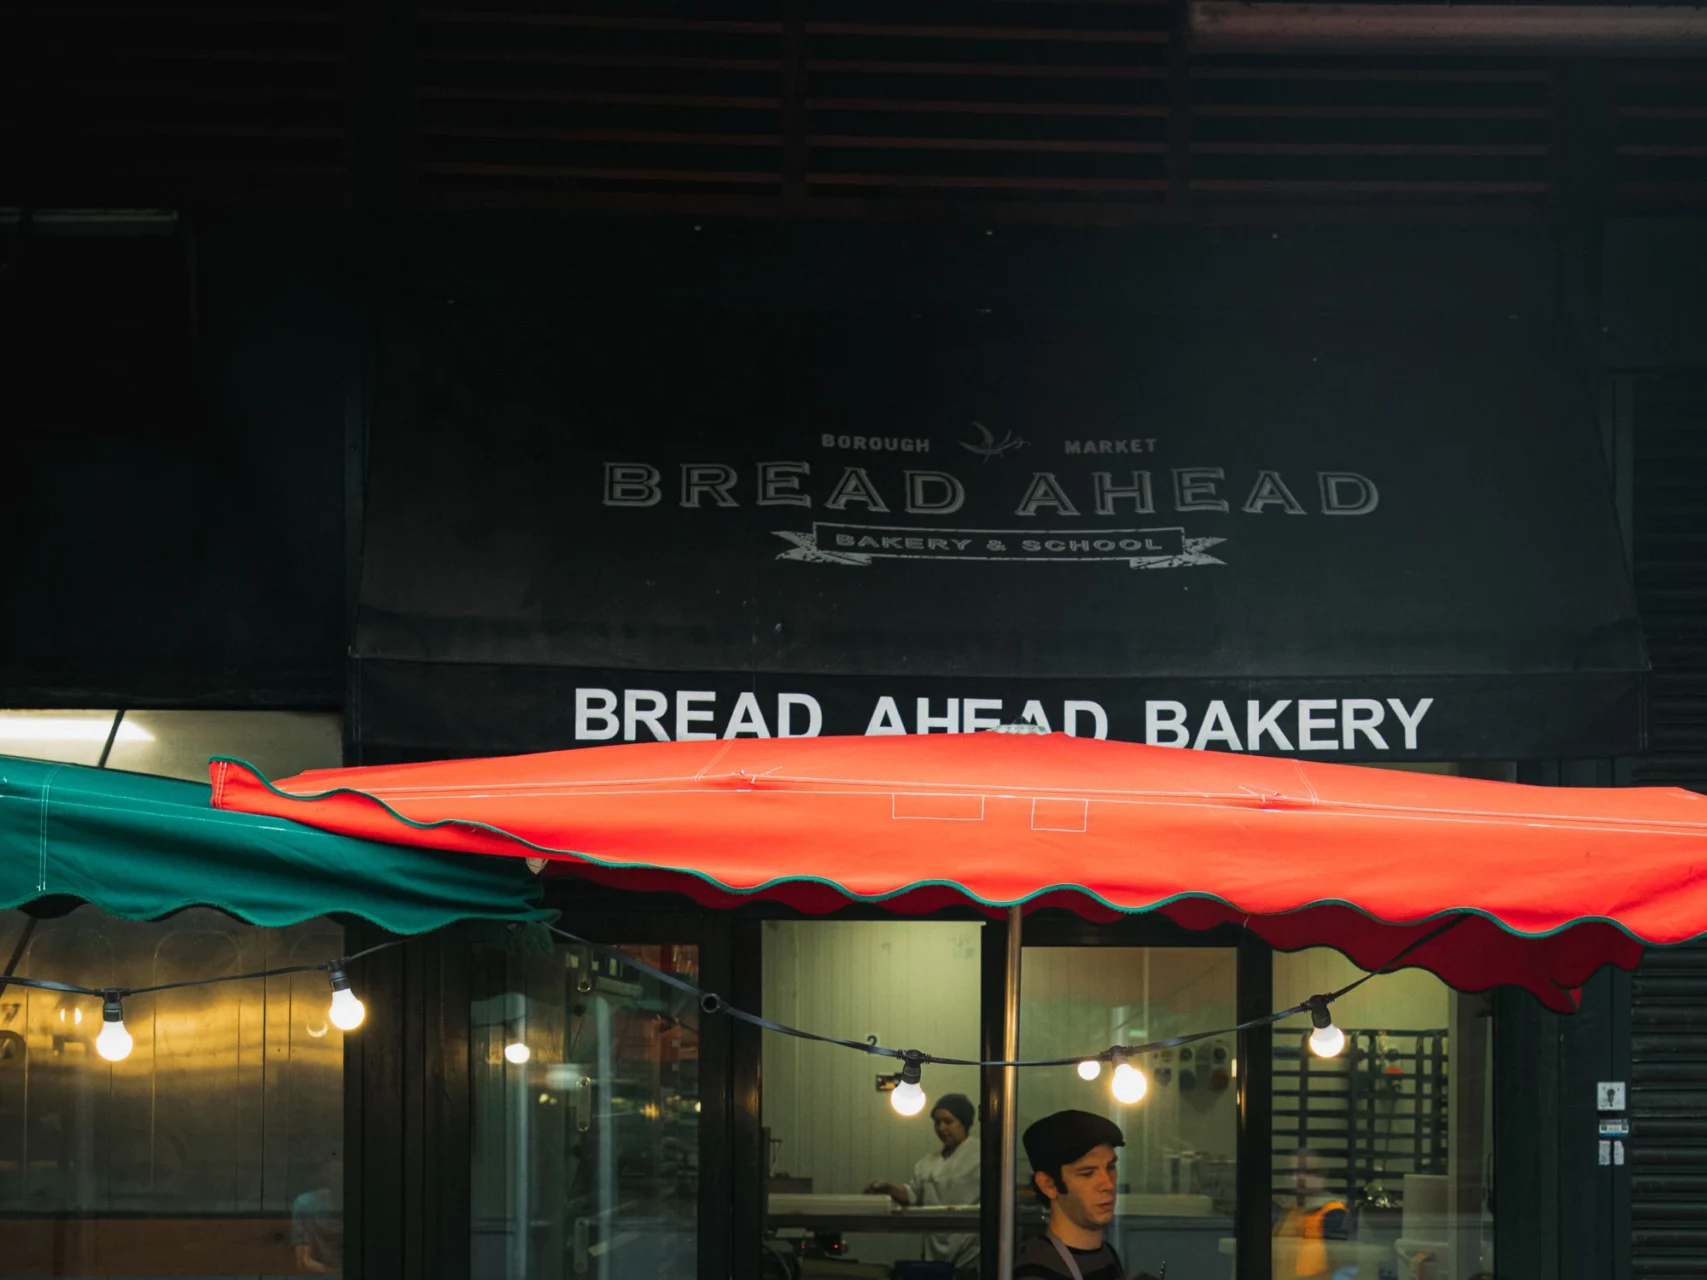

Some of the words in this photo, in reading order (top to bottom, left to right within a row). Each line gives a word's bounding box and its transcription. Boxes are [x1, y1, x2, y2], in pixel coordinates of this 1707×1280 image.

[822, 432, 930, 454] BOROUGH
[1065, 436, 1158, 456] MARKET
[601, 461, 965, 516] BREAD
[1015, 466, 1380, 518] AHEAD
[835, 532, 972, 552] BAKERY
[986, 536, 1006, 553] &
[1022, 536, 1164, 553] SCHOOL
[574, 688, 823, 742] BREAD
[1145, 698, 1434, 750] BAKERY
